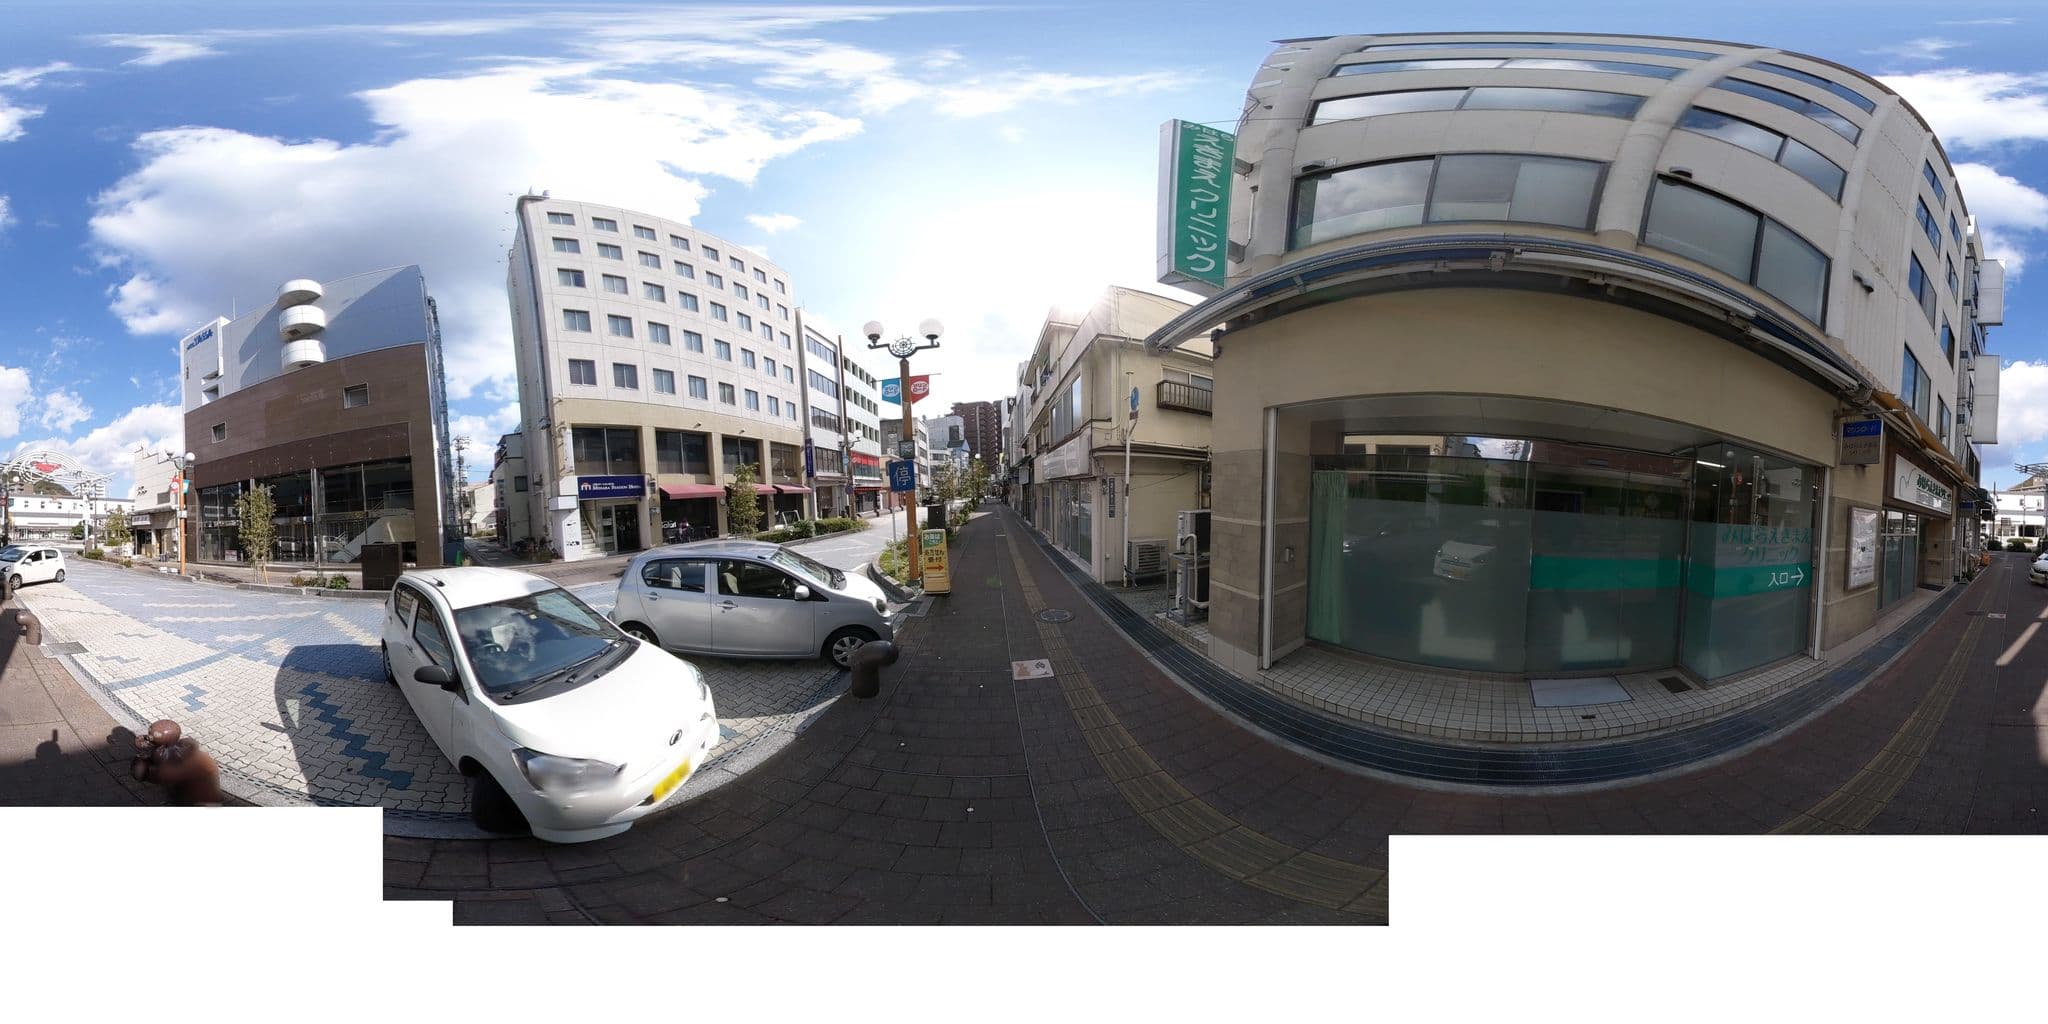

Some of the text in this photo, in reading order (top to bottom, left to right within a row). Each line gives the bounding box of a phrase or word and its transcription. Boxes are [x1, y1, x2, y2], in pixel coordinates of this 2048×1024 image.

[894, 466, 911, 486] 停
[1746, 546, 1799, 562] クリニック
[1767, 572, 1789, 587] 入口
